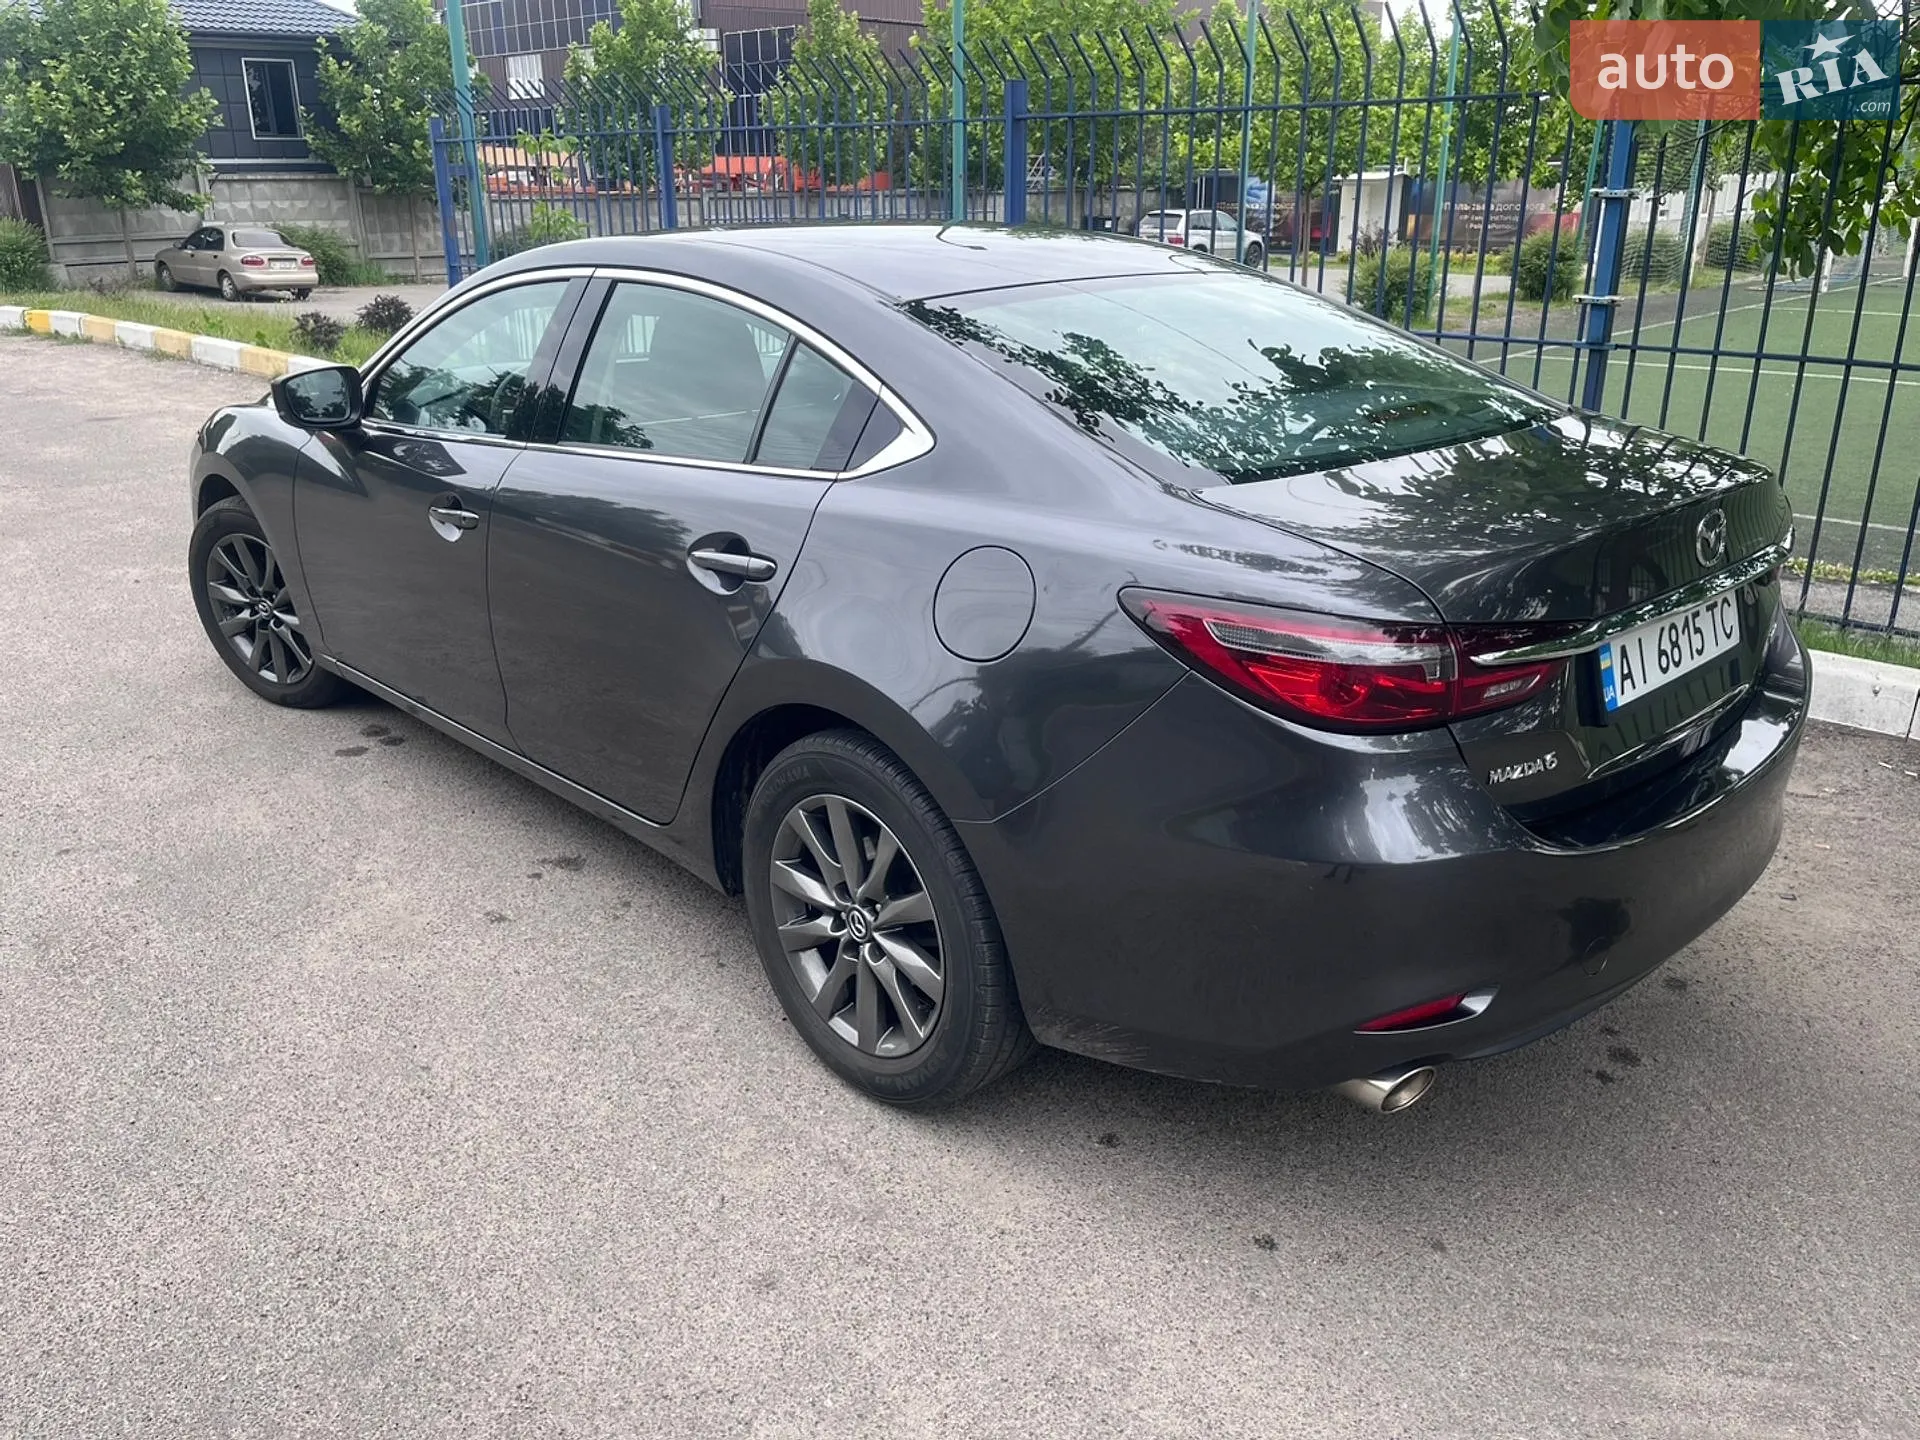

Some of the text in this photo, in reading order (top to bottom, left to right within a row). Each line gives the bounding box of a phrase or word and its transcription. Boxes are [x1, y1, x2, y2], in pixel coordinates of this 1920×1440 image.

[1620, 597, 1733, 696] AI 6815 TC
[1603, 685, 1616, 703] UA
